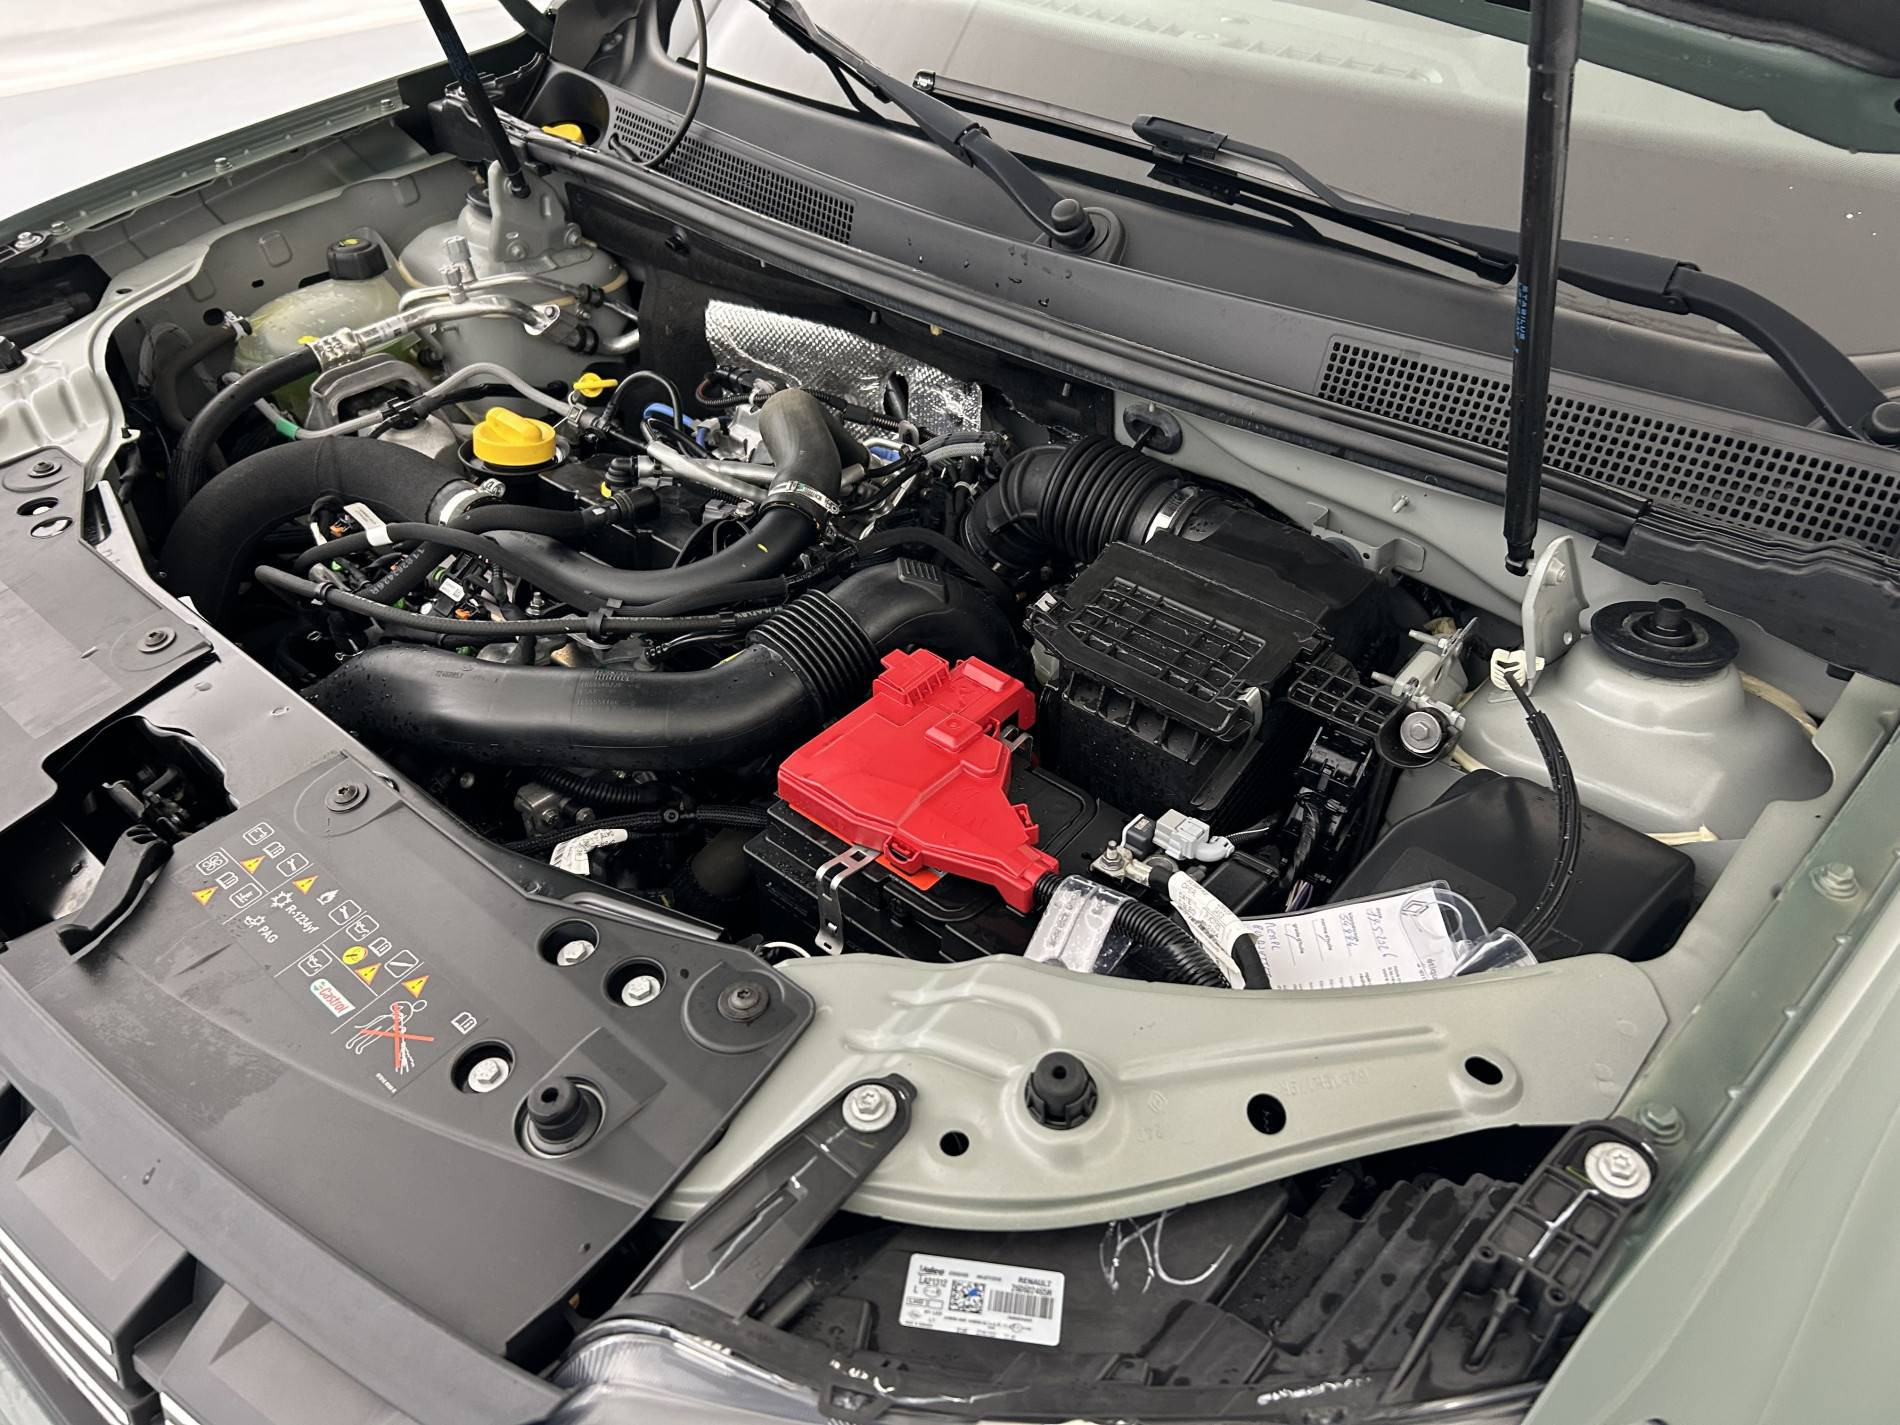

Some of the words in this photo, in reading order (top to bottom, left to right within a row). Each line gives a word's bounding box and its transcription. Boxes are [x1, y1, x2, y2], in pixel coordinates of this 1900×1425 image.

[1519, 285, 1528, 340] STABILUS
[257, 923, 279, 944] PAG
[318, 986, 350, 1014] Castrol
[1018, 1276, 1052, 1286] RENAULT
